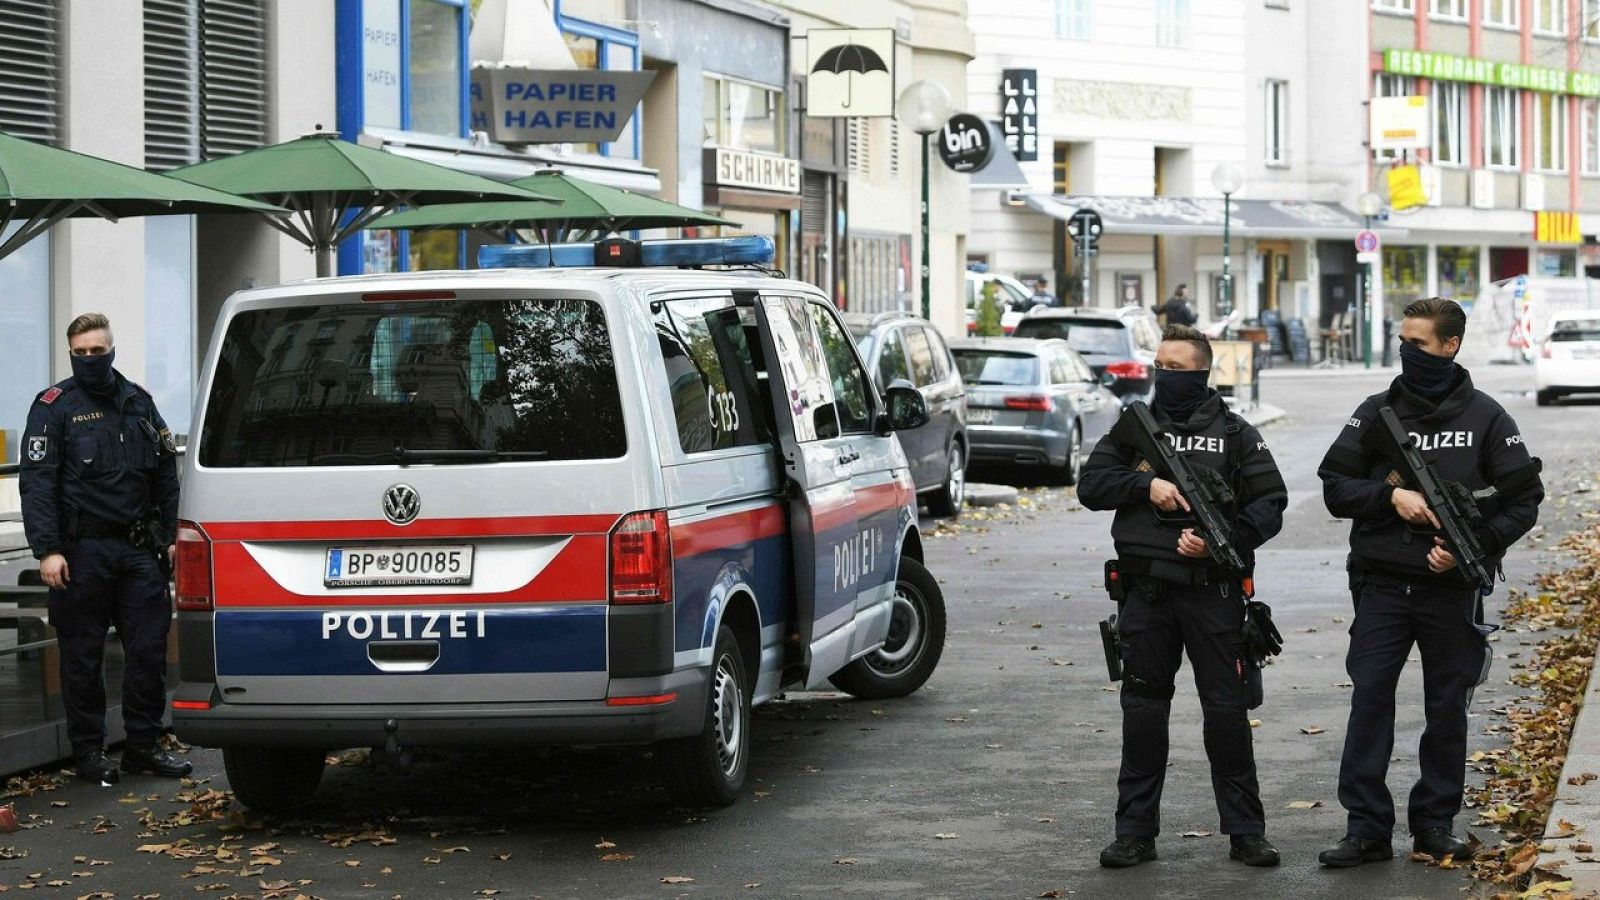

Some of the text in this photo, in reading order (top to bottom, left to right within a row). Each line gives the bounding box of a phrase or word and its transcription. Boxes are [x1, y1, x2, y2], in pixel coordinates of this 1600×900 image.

[365, 28, 397, 48] PAPIER
[366, 69, 396, 87] HAFEN
[1389, 50, 1495, 86] RESTAURANT
[1501, 64, 1567, 92] CHINESE
[505, 83, 616, 101] PAPIER
[504, 110, 616, 130] HAFEN
[1023, 78, 1036, 153] LALE
[944, 121, 983, 152] bin
[721, 152, 796, 188] SCHIRME
[72, 412, 103, 423] POLIZEI
[716, 391, 740, 431] 133
[1408, 431, 1474, 451] OLIZEI
[348, 553, 375, 575] BP
[391, 551, 462, 574] 90085
[834, 527, 875, 593] POLIEI
[322, 611, 485, 640] POLIZEI
